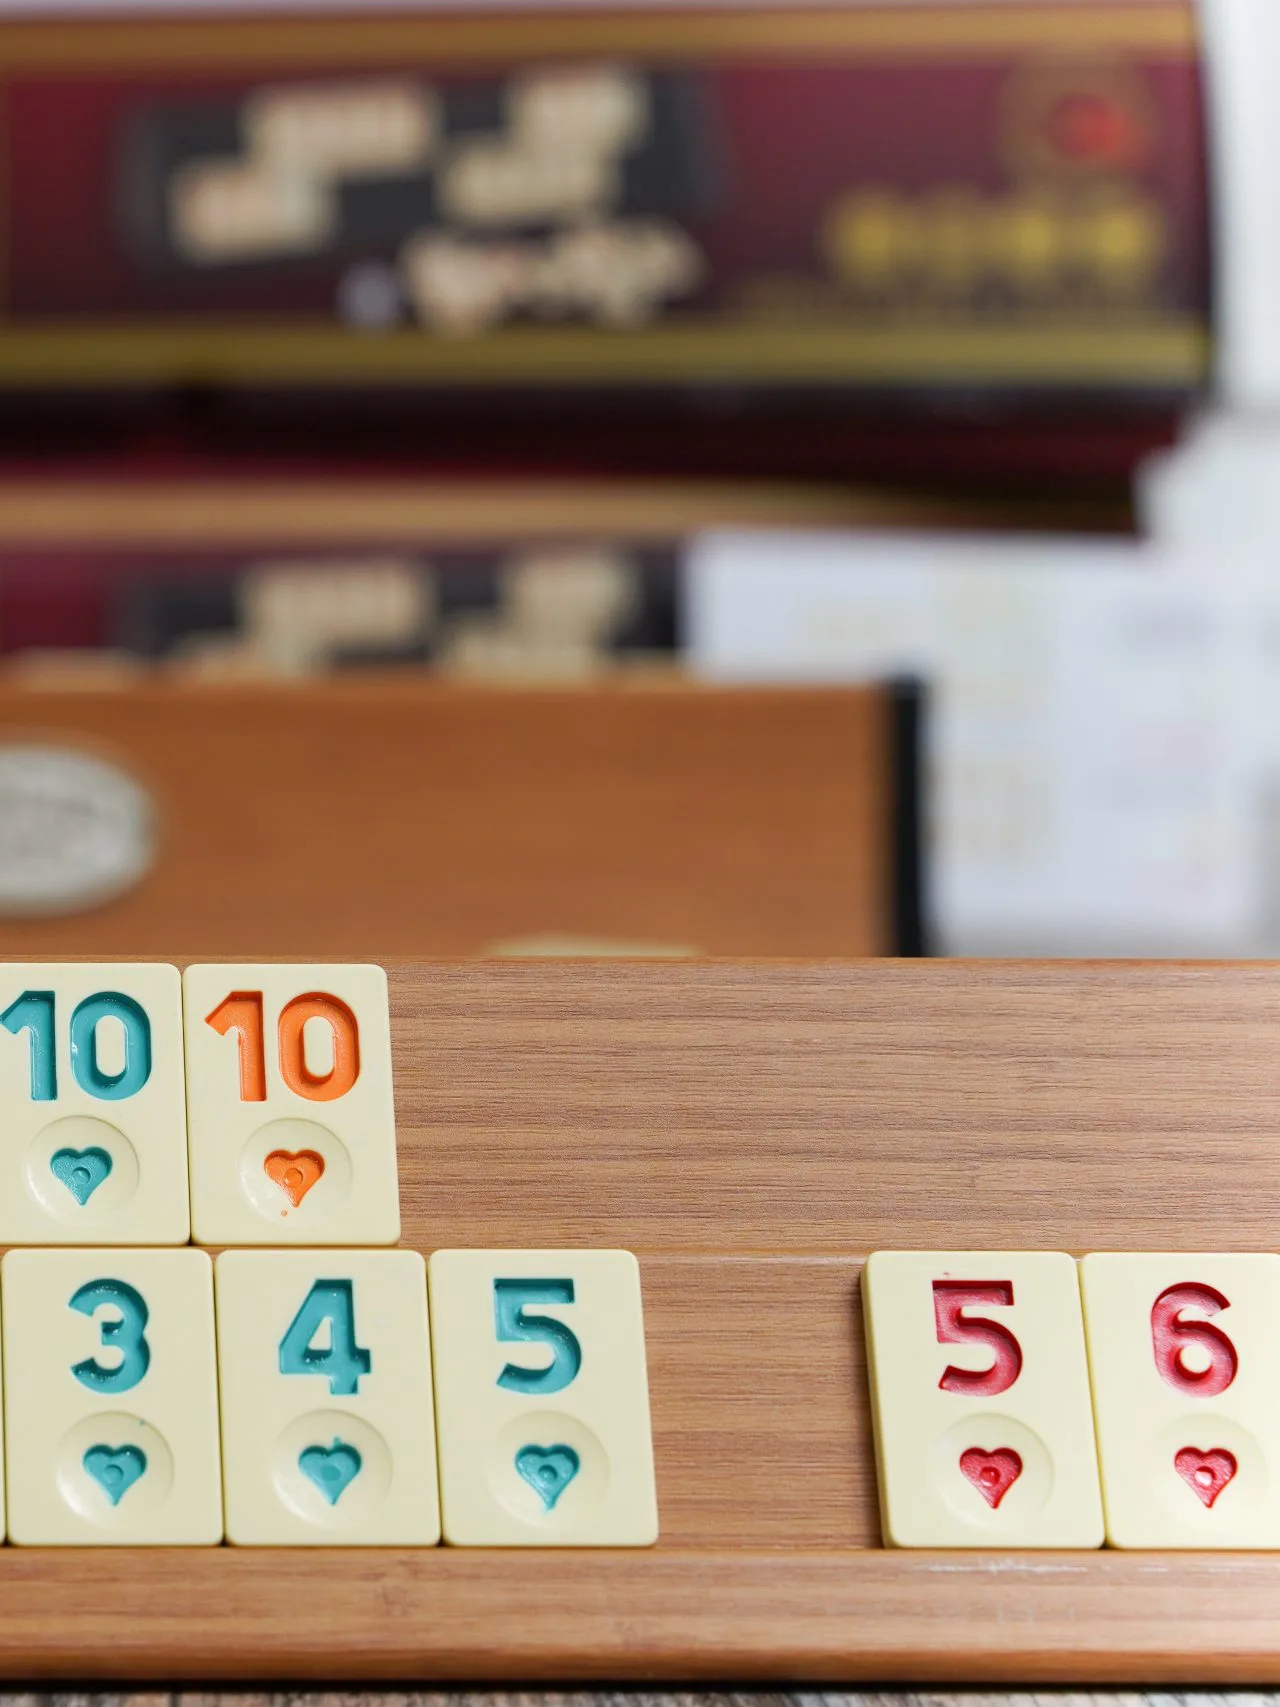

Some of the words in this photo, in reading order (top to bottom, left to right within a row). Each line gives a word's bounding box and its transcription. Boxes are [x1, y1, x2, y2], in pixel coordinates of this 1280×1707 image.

[206, 991, 360, 1101] 10
[70, 1279, 150, 1392] 3
[280, 1279, 370, 1394] 4
[494, 1279, 581, 1392] 5
[933, 1281, 1022, 1394] 5
[1152, 1283, 1238, 1394] 6
